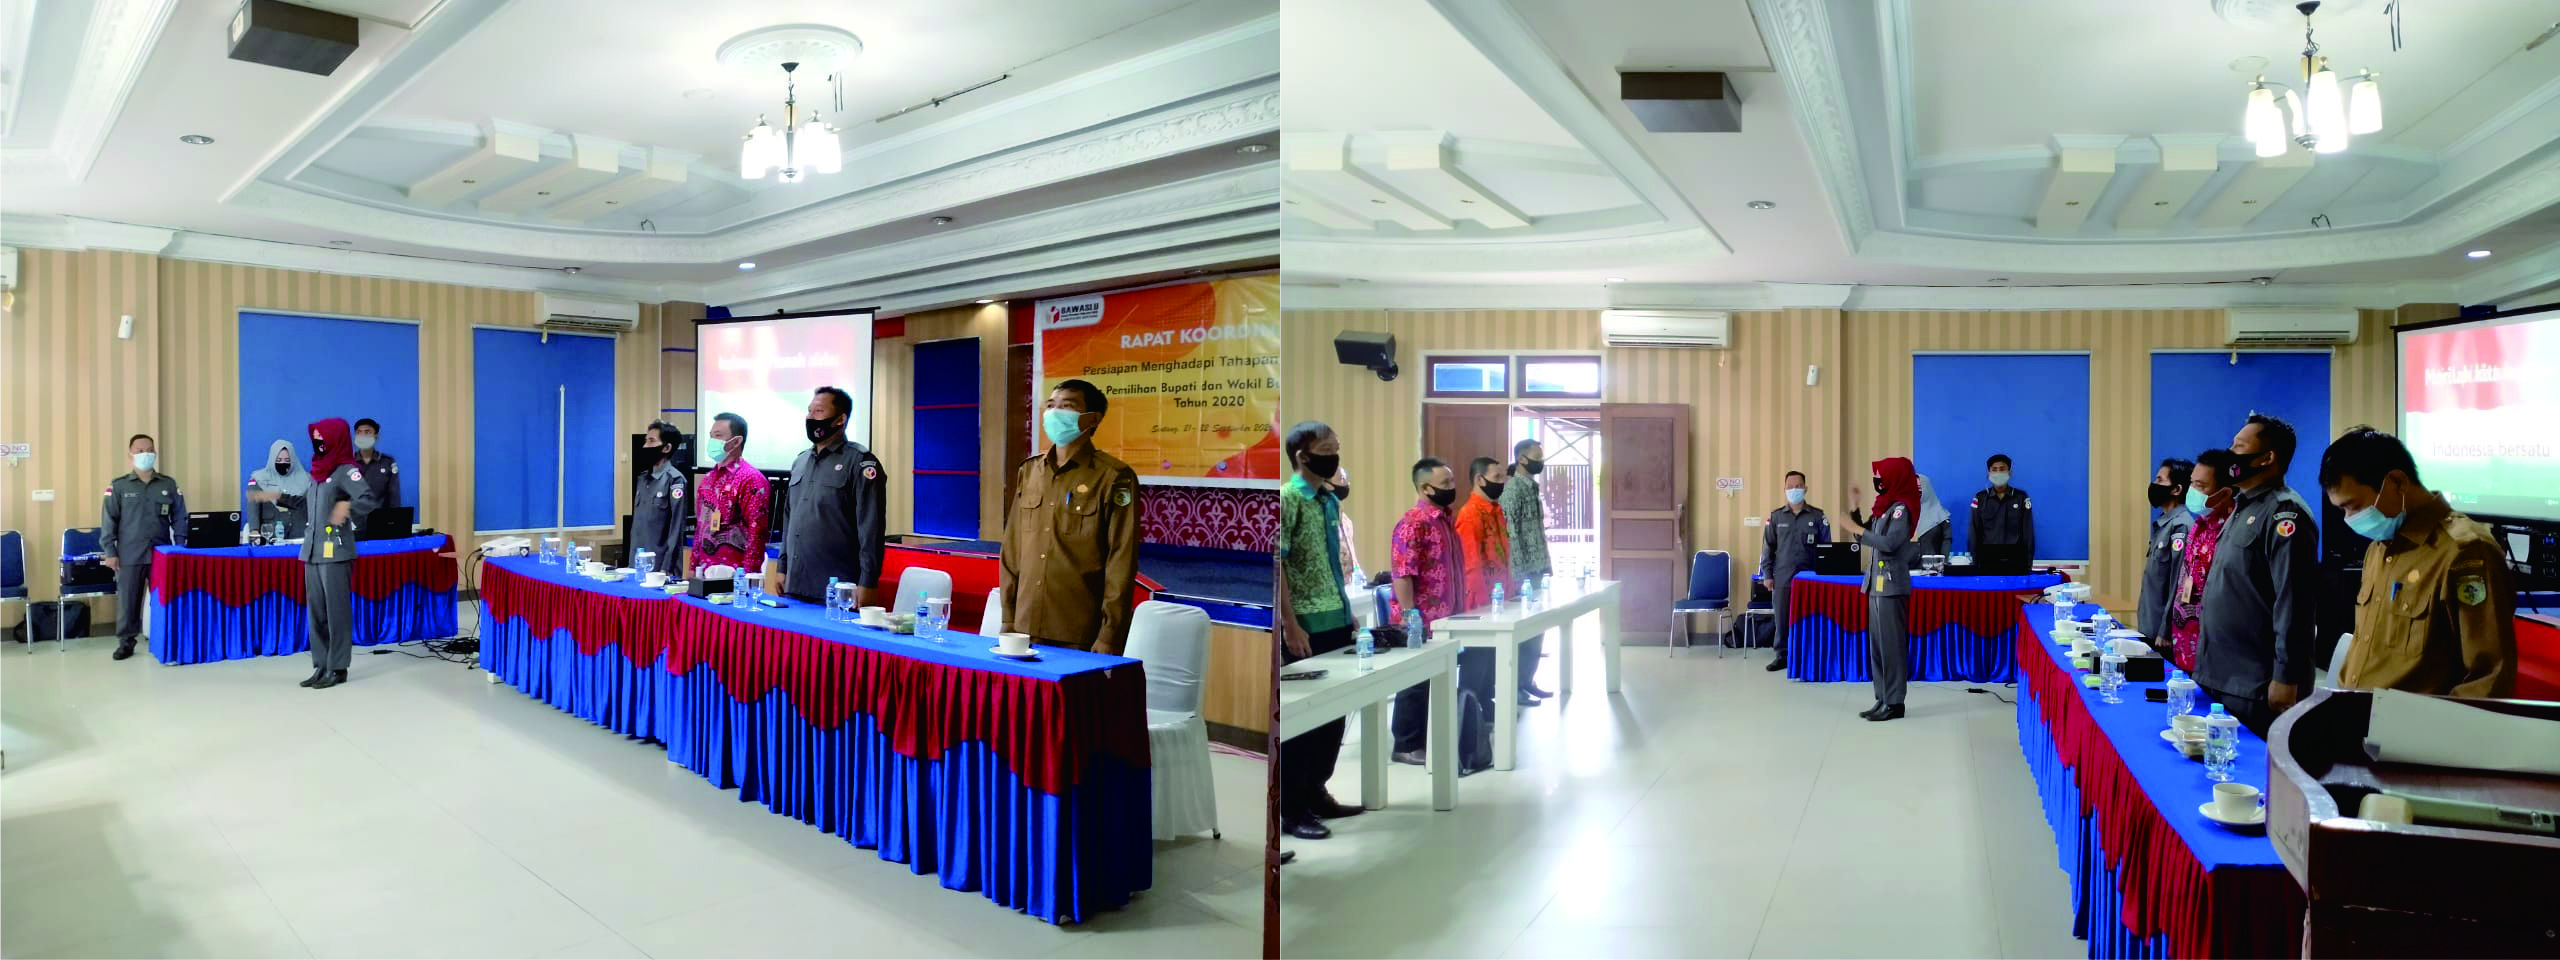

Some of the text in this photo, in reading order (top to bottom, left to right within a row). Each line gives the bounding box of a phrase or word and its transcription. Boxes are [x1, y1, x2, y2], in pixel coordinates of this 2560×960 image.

[1120, 330, 1175, 348] RAPAT
[1083, 355, 1279, 376] Persiapan Menghadapi Tahapan
[1106, 384, 1157, 395] Pemilihan
[1161, 381, 1197, 394] Bupati
[1201, 380, 1222, 391] dan
[1227, 378, 1262, 389] Wakil
[1173, 395, 1245, 408] Tahun 2020
[2498, 441, 2550, 457] bersatu
